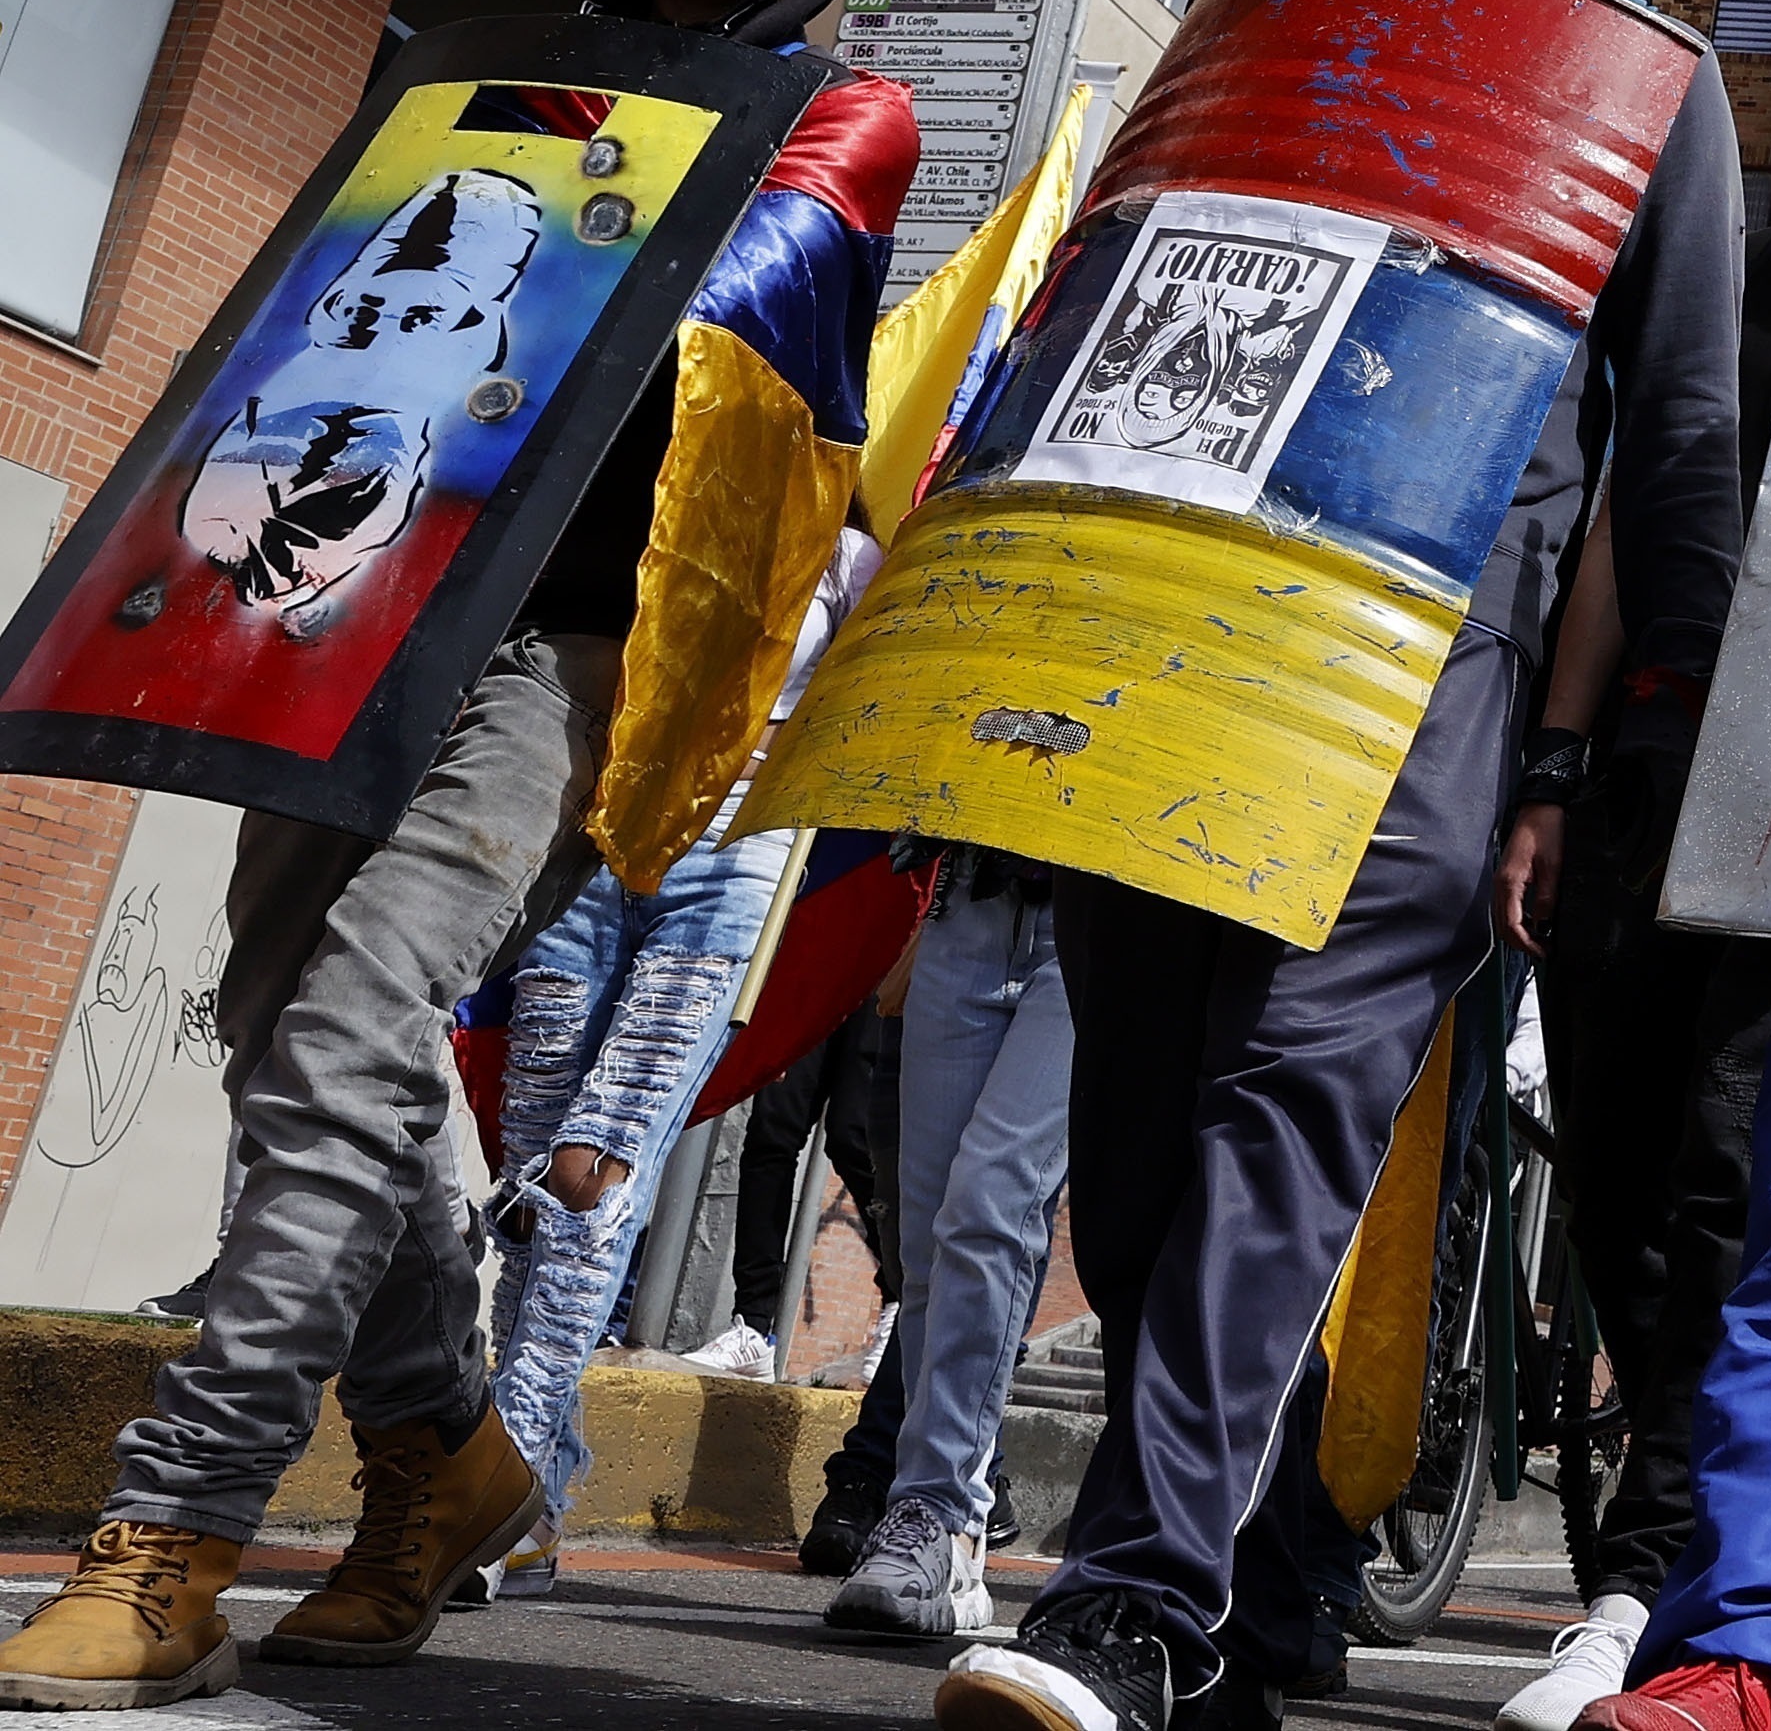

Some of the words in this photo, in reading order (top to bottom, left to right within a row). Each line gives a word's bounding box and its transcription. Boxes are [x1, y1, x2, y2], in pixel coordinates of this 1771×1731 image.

[856, 14, 885, 28] 59B
[895, 15, 904, 25] El
[906, 15, 938, 27] Cortijo
[850, 44, 875, 57] 166
[887, 45, 943, 56] Porciúncula
[926, 165, 943, 176] AV.
[946, 165, 970, 176] Chile
[927, 177, 938, 186] AK
[947, 177, 958, 186] AK
[904, 194, 927, 205] trial
[929, 193, 965, 205] Álamos
[906, 238, 918, 246] AK
[919, 238, 925, 246] 7
[896, 269, 907, 277] AC
[1156, 242, 1319, 295] ¡CARAJO!
[1105, 400, 1118, 411] se
[1068, 412, 1106, 439] NO
[1197, 438, 1213, 452] El
[927, 867, 951, 923] MILAN
